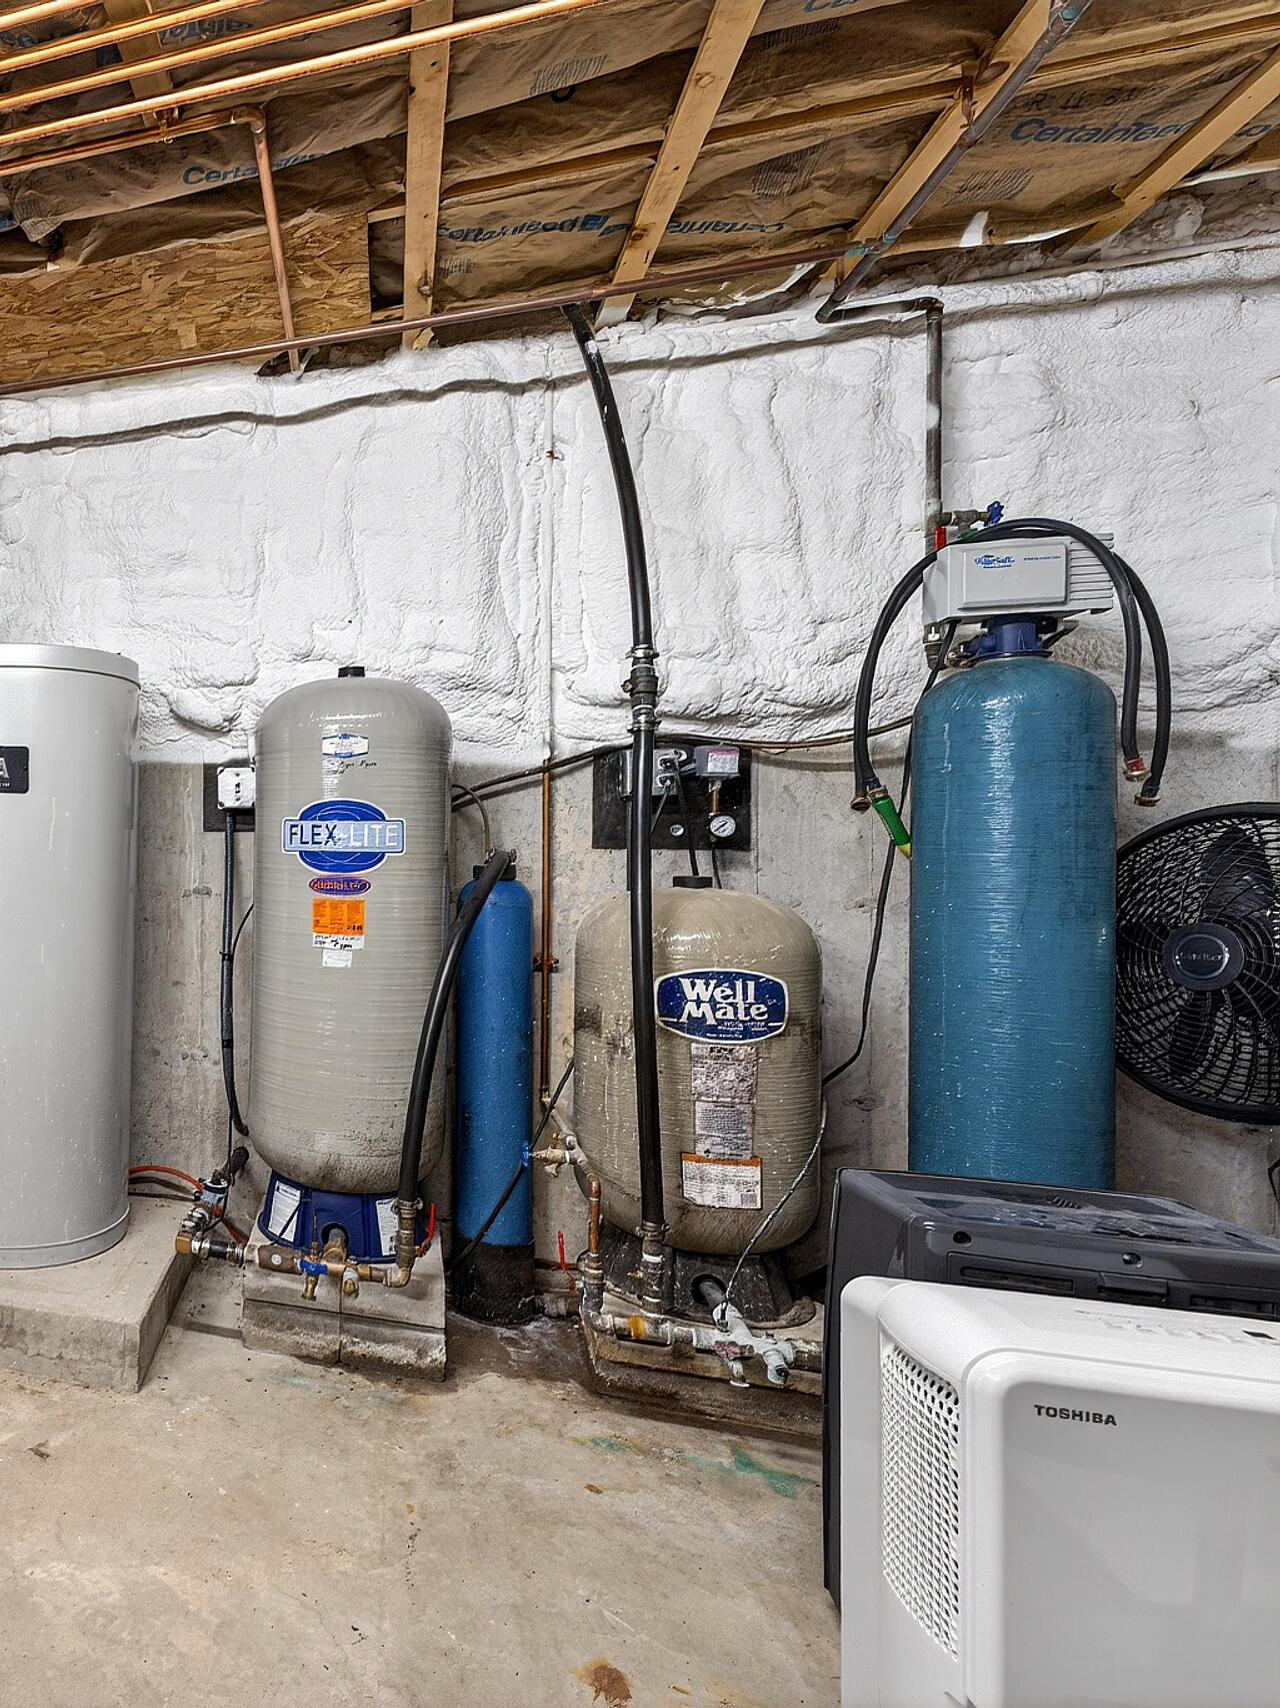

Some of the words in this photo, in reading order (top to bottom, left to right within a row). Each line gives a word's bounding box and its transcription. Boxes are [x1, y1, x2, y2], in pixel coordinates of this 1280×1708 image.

[678, 977, 756, 1004] Well
[678, 1000, 769, 1026] Mate
[1033, 1403, 1118, 1427] TOSHIBA
